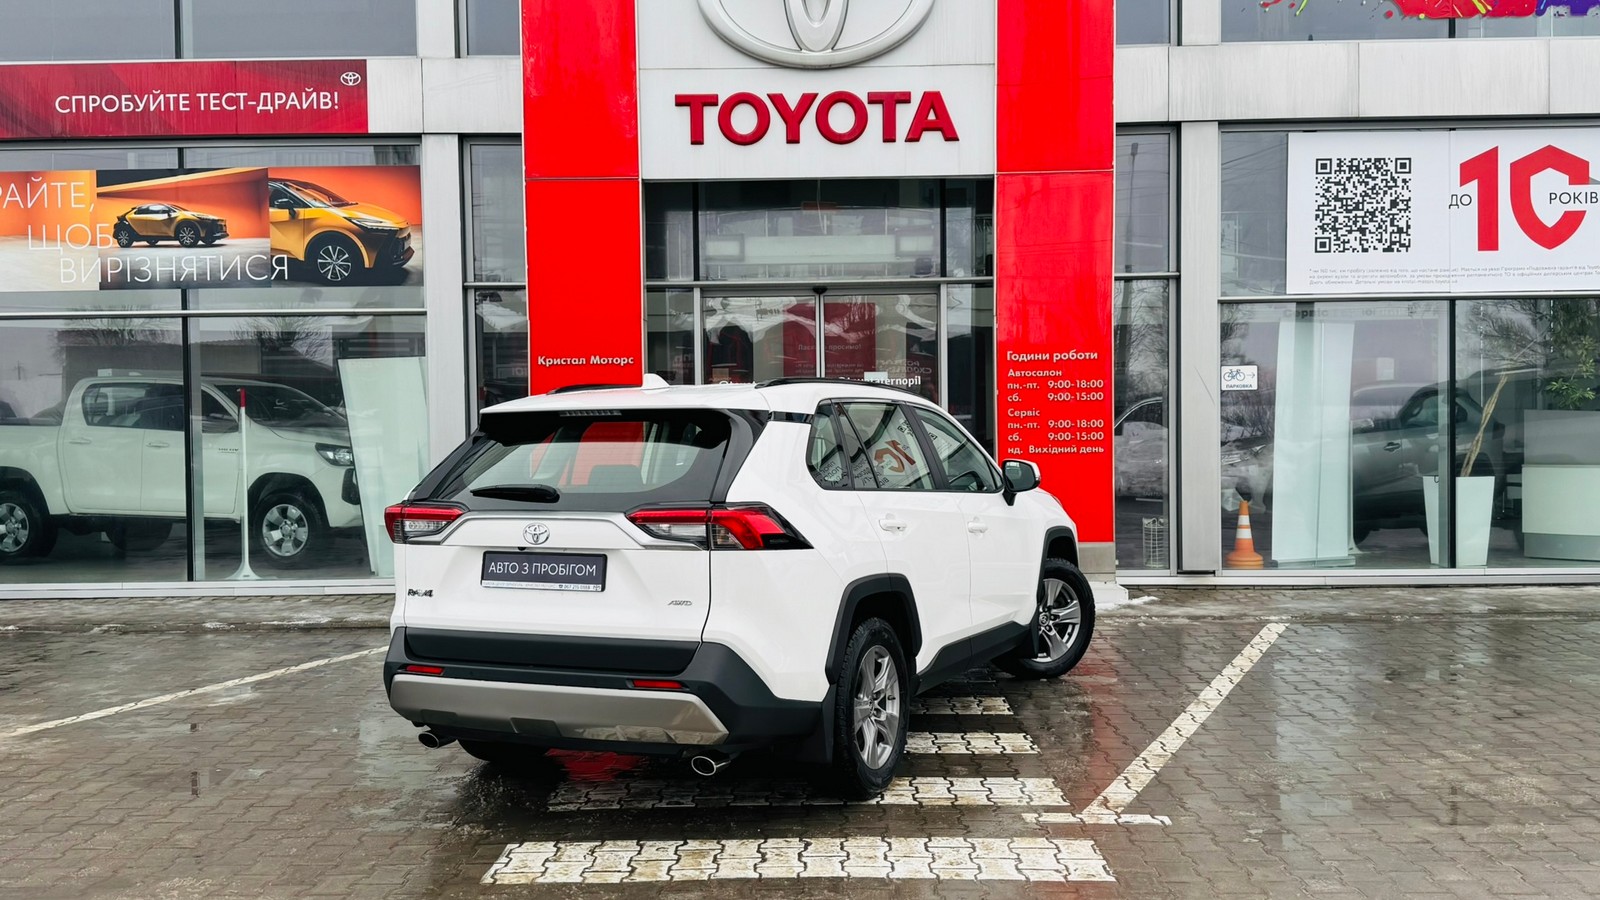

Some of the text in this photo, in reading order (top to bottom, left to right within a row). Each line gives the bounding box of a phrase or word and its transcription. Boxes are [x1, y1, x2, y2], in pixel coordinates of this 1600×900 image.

[55, 88, 339, 114] СПРОБУЙТЕ ТЕСТ-ДРАЙВ!
[675, 90, 960, 146] TOYOTA
[1449, 193, 1472, 209] ДО
[1549, 191, 1599, 205] РОКІВ
[28, 223, 113, 255] ЩОБ
[60, 254, 288, 284] ВИРІЗНЯТИСЯ
[537, 354, 635, 367] Кристал Моторс
[1006, 349, 1098, 363] Години роботи
[1007, 368, 1063, 378] Автосалон
[1007, 393, 1022, 402] сб.
[1007, 408, 1041, 419] Сервіс
[1007, 432, 1022, 442] сб.
[1007, 444, 1105, 455] нд. Вихідний день
[488, 562, 519, 574] АВТО
[532, 563, 597, 577] ПРОБІГОМ
